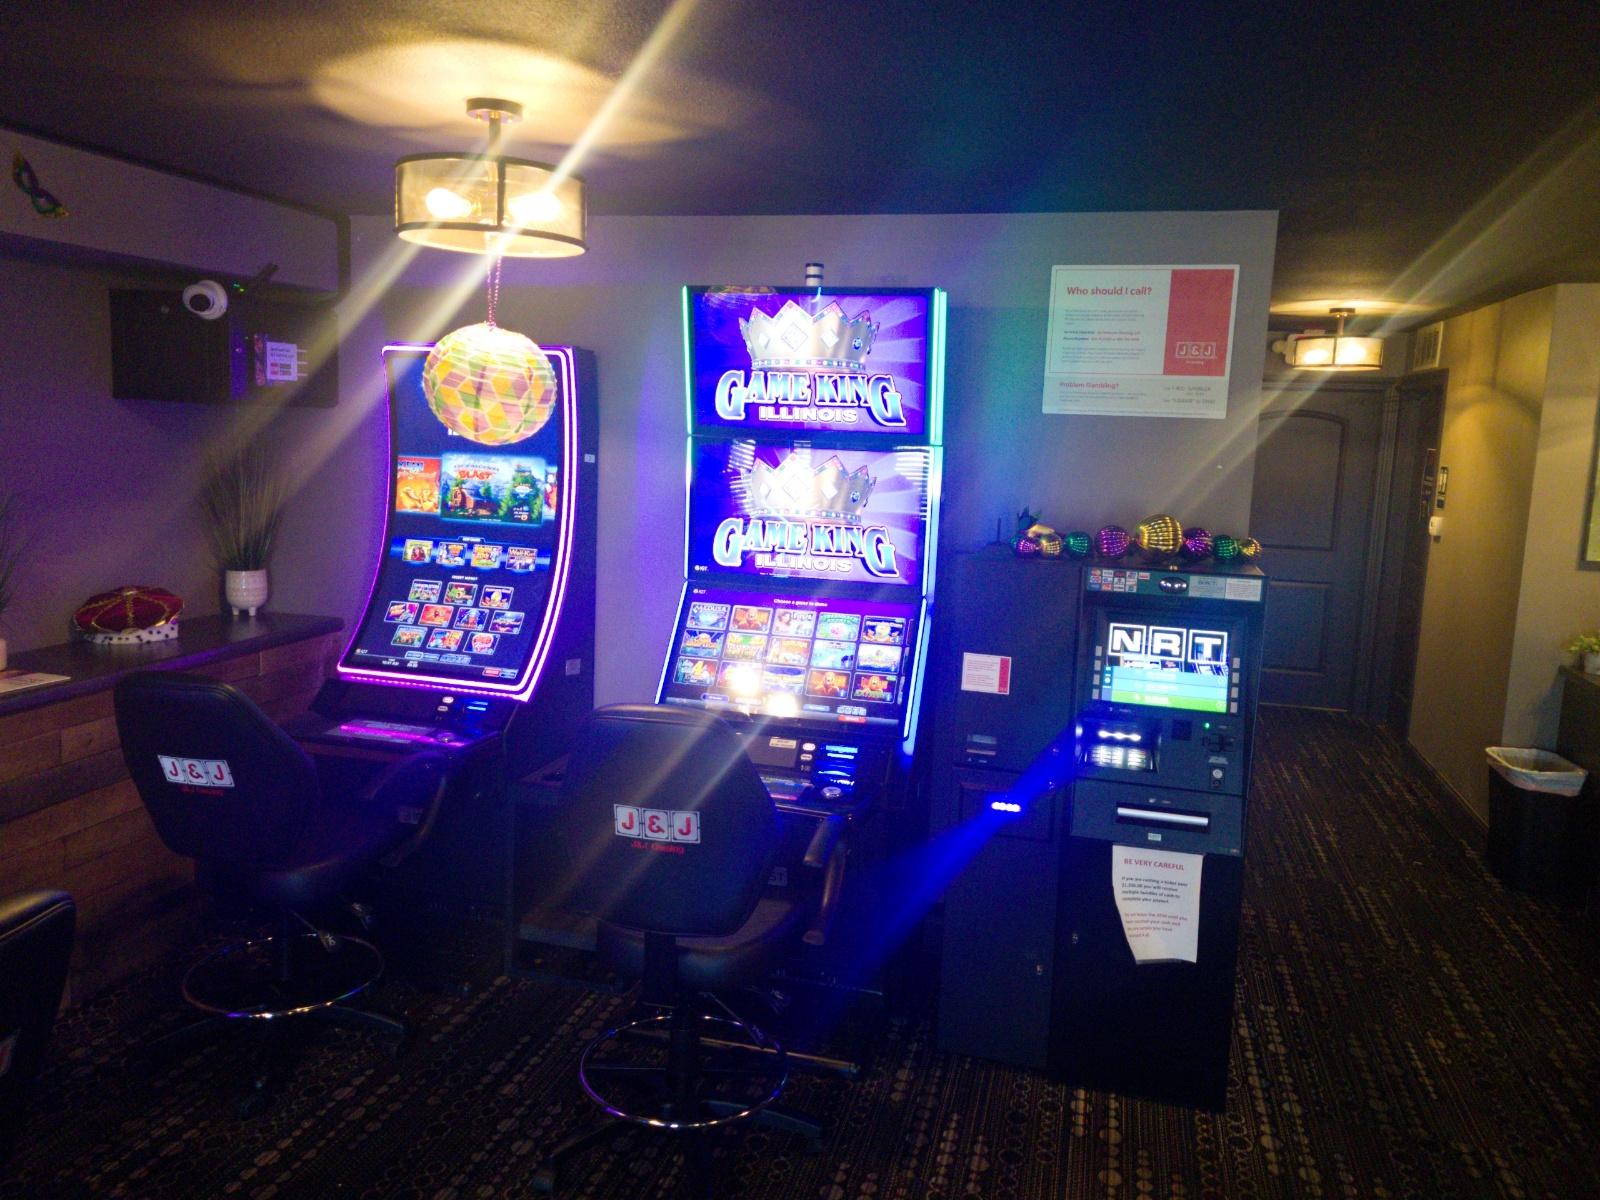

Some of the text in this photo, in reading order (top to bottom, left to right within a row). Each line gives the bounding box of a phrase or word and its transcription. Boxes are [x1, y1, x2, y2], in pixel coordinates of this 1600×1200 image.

[1067, 286, 1088, 296] Who
[1091, 286, 1123, 296] should
[1130, 286, 1152, 296] call?
[715, 370, 906, 427] GAME KING
[759, 406, 857, 423] ILLINOIS
[713, 518, 899, 578] GAME KING
[755, 553, 852, 573] ILLINOIS
[1111, 628, 1222, 662] NRT
[1134, 859, 1152, 867] VERY
[1153, 861, 1184, 870] CAREFUL
